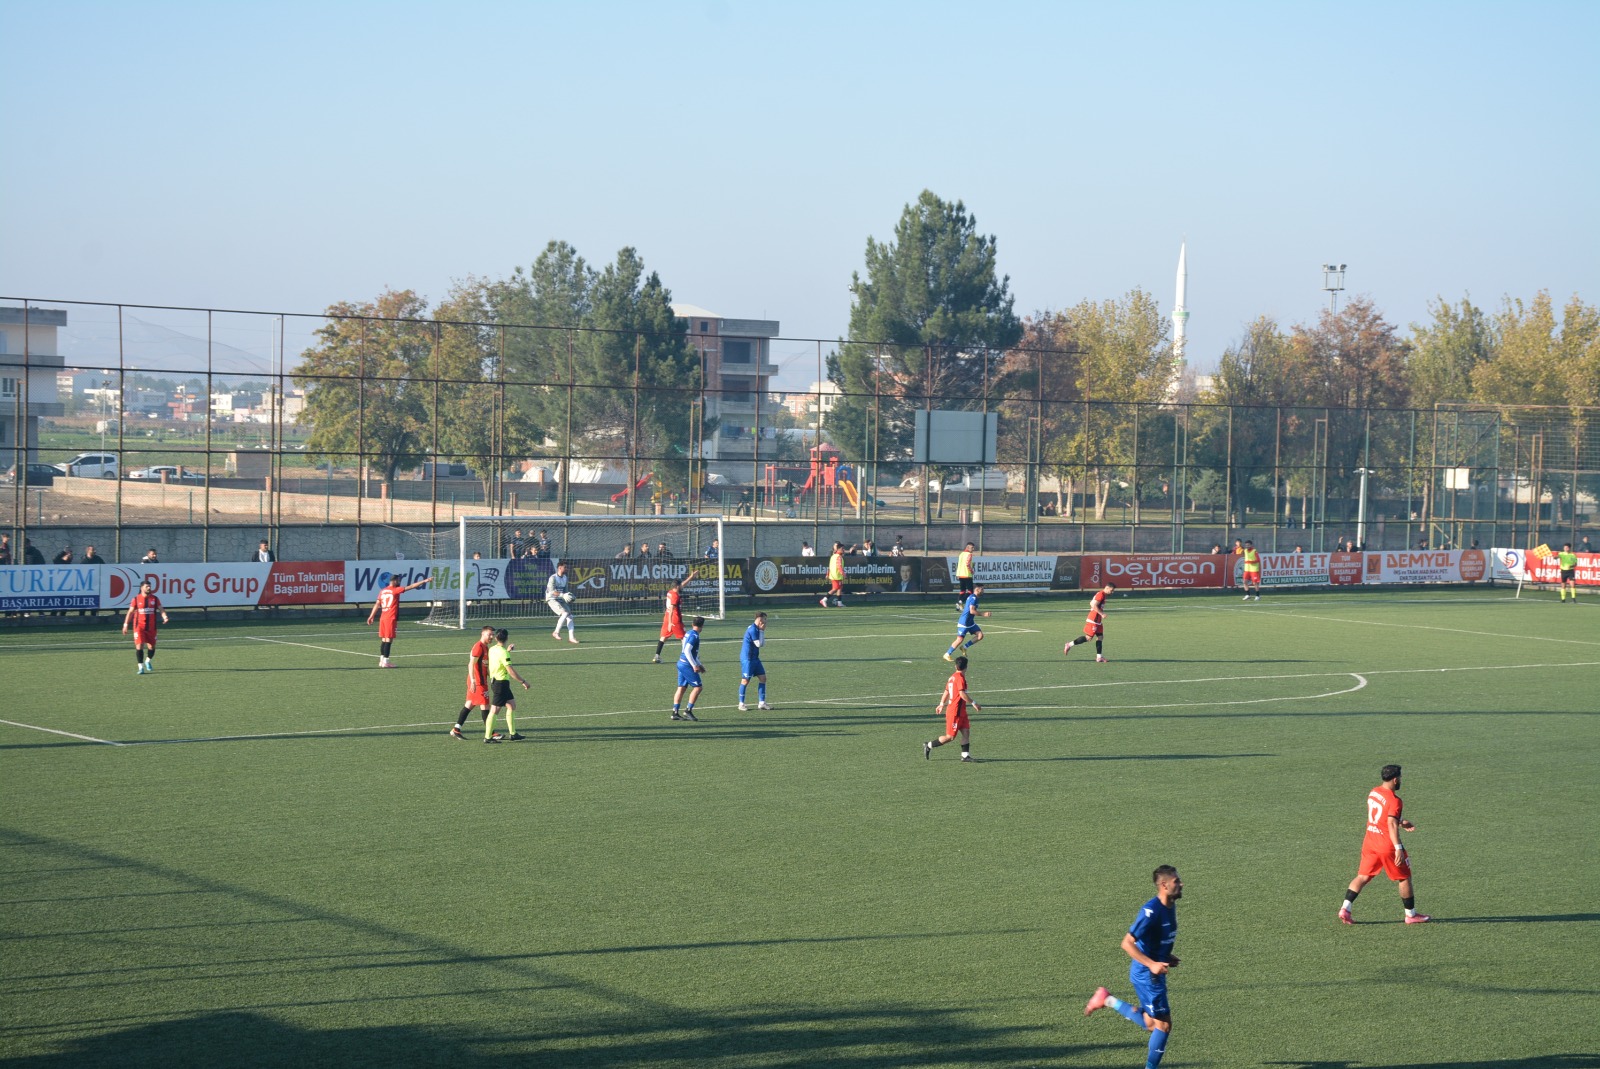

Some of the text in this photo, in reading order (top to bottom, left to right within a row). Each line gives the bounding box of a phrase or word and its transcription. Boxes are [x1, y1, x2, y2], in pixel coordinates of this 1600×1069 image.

[977, 561, 1001, 572] EMLAK
[1003, 558, 1052, 572] GAYRİMENKUL
[1309, 555, 1328, 568] ET
[1387, 553, 1454, 568] DEMYOL
[610, 564, 651, 580] YAYLA
[652, 564, 686, 580] GRUP
[780, 563, 796, 574] Tüm
[798, 564, 829, 574] Takımlar
[867, 563, 896, 574] Dilerim.
[1090, 562, 1100, 583] Özel
[1105, 558, 1215, 585] beycan
[1263, 569, 1294, 577] ENTEGRE
[272, 571, 345, 583] Tüm Takımlara
[1001, 573, 1034, 581] BAŞARILAR
[1035, 572, 1052, 580] DİLER
[1131, 576, 1194, 586] Src Kursu
[145, 572, 259, 599] Dinç Grup
[274, 582, 344, 596] Başarılar Diler
[2, 595, 95, 609] BAŞARILAR DİLER
[380, 593, 394, 608] 37
